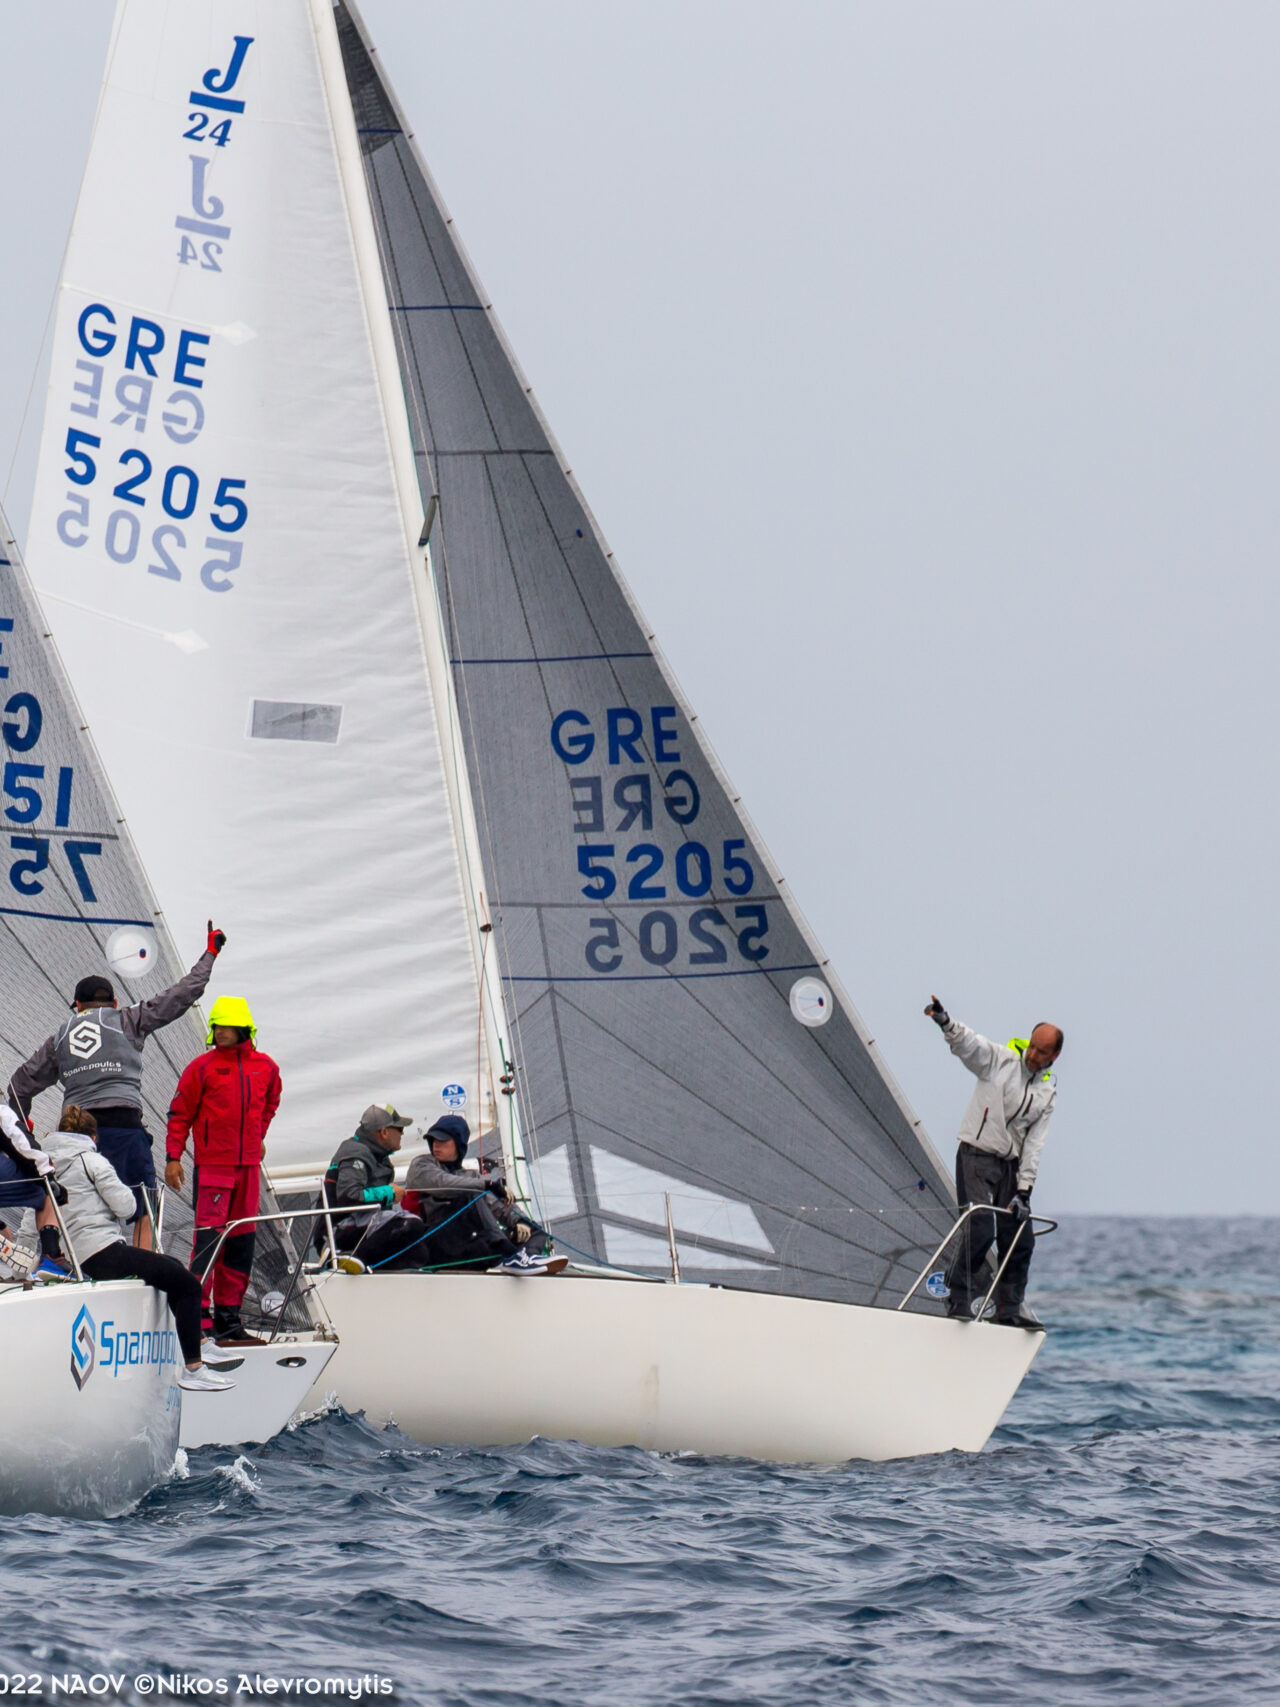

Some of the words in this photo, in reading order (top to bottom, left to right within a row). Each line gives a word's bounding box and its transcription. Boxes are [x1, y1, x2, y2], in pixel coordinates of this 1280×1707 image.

[202, 35, 254, 93] J
[182, 112, 233, 147] 24
[77, 303, 211, 388] GRE
[64, 426, 249, 533] 5205
[551, 706, 681, 765] GRE
[577, 839, 754, 900] 5205
